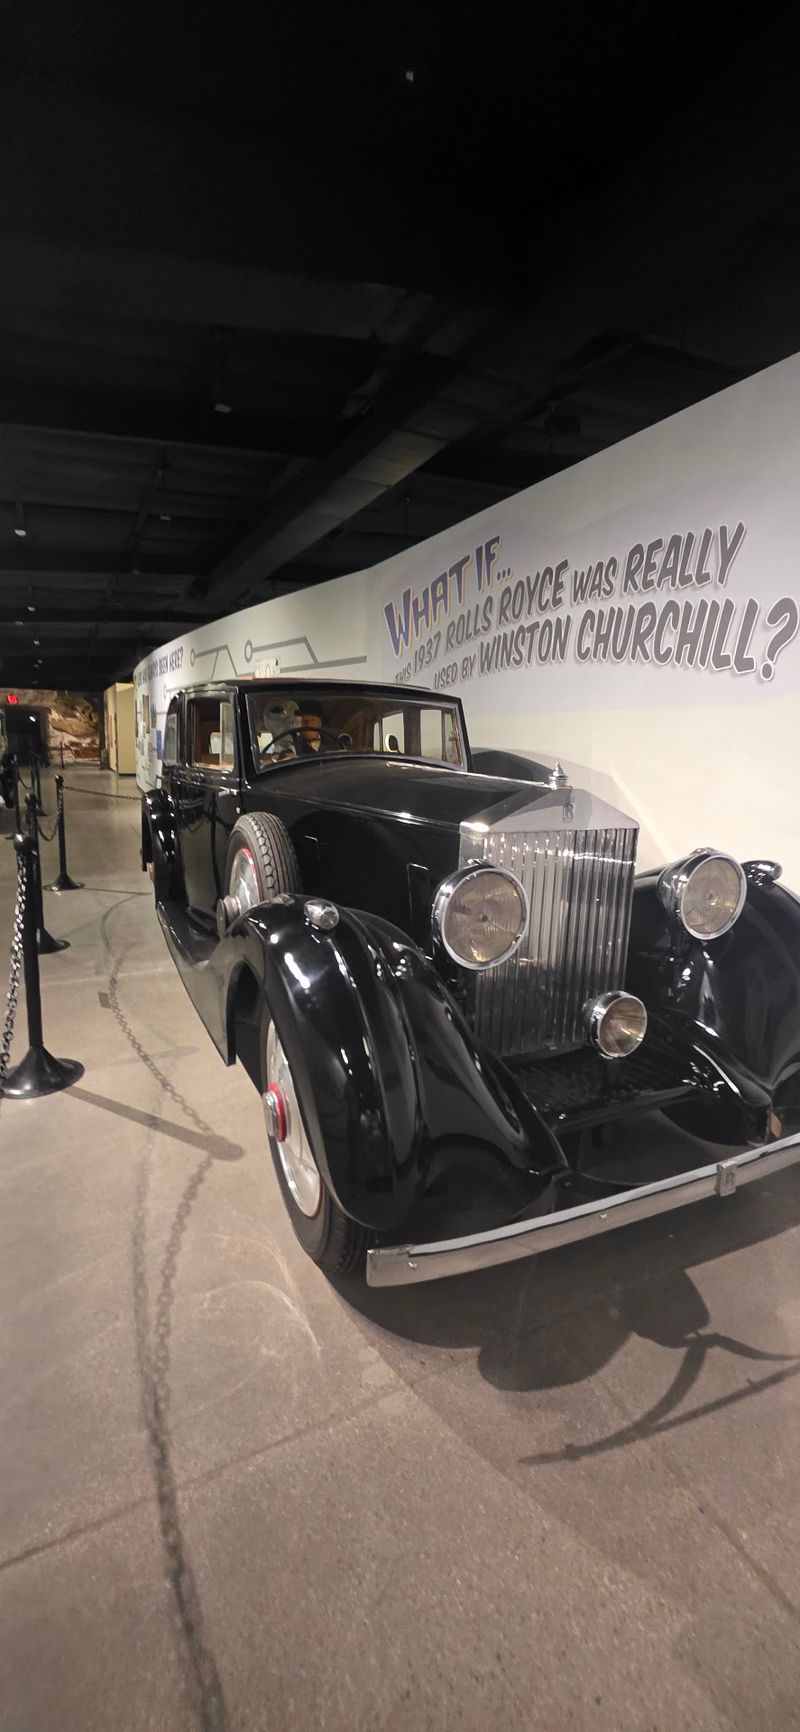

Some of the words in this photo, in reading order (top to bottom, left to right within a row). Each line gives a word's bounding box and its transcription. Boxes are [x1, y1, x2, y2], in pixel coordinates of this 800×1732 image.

[384, 554, 471, 656] WHAT
[475, 535, 511, 592] IF...
[394, 662, 411, 685] THIS
[413, 630, 442, 674] 1937
[446, 595, 493, 651] ROLLS
[500, 559, 569, 624] ROYCE
[573, 556, 617, 603] WAS
[623, 521, 745, 594] REALLY
[434, 661, 458, 690] USED
[461, 653, 476, 680] BY
[479, 614, 572, 674] WINSTON
[576, 597, 799, 680] CHURCHILL?
